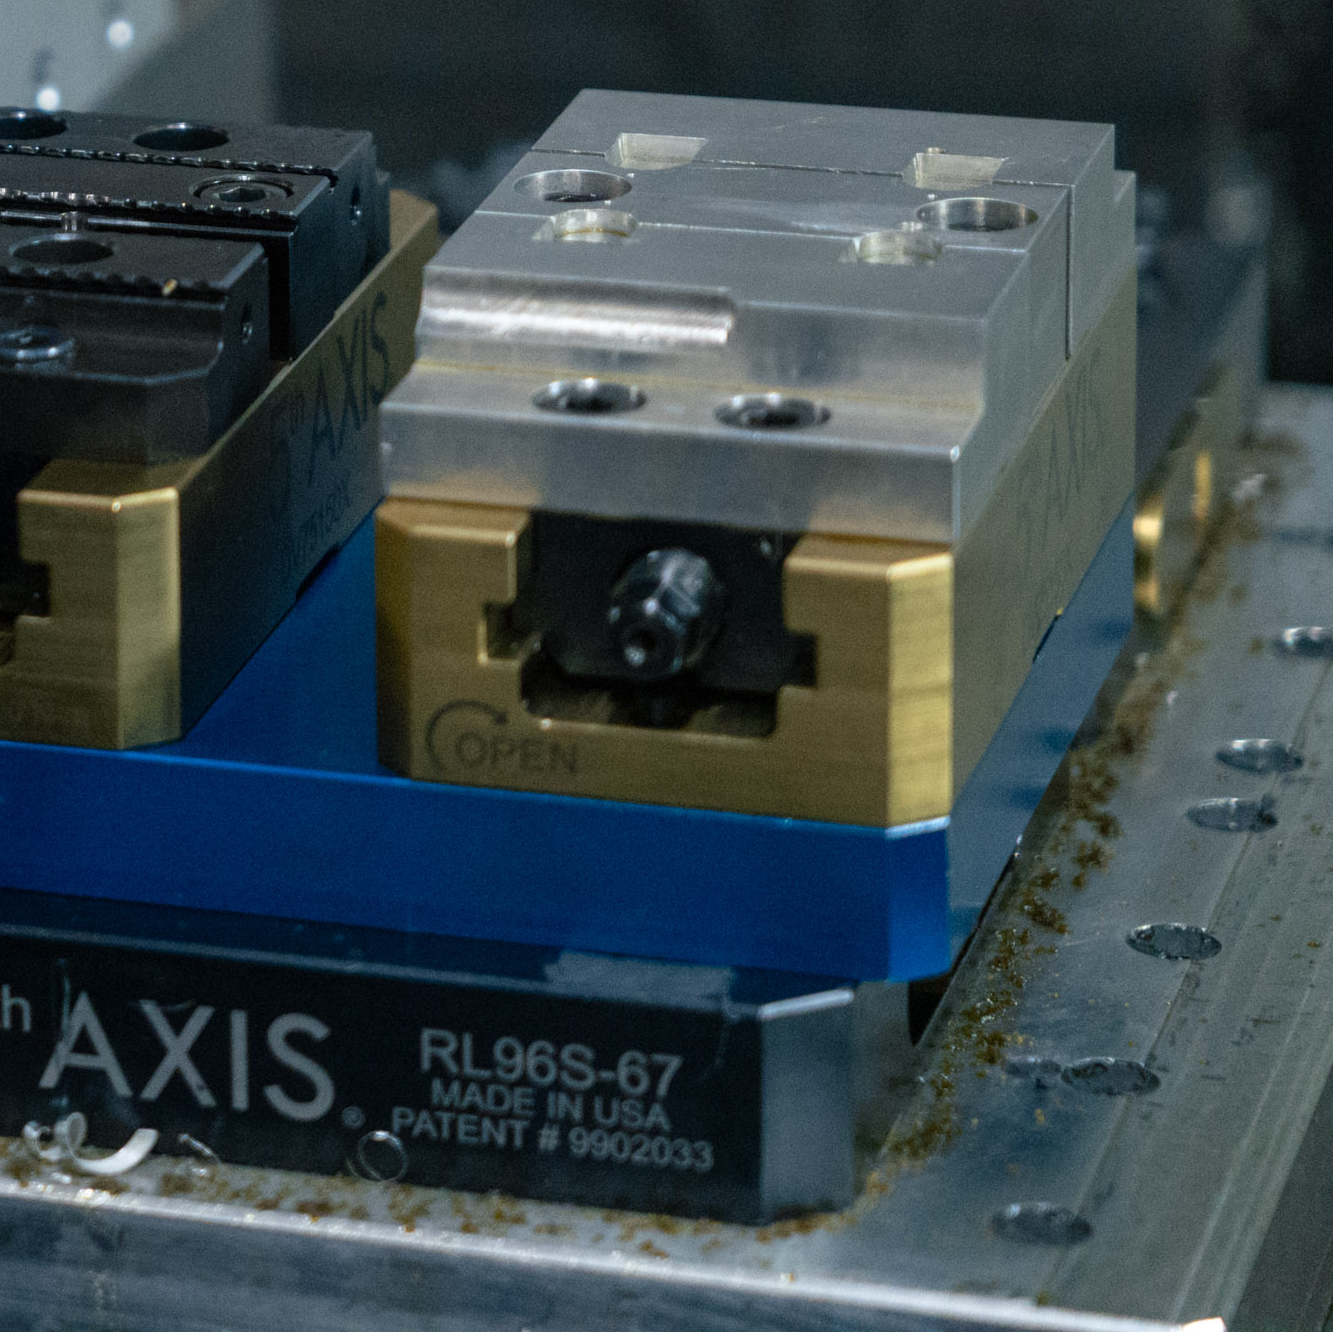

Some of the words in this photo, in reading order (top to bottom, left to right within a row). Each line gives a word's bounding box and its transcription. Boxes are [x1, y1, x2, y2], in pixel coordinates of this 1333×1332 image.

[307, 291, 390, 486] AXIS
[455, 731, 579, 774] OPEN
[39, 991, 335, 1121] AXIS
[420, 1027, 684, 1099] RL96S-67
[432, 1076, 533, 1116] MADE
[546, 1091, 584, 1123] IN
[593, 1095, 671, 1133] USA
[391, 1106, 531, 1151] PATENT
[538, 1124, 561, 1153] #
[568, 1128, 715, 1173] 9902033
